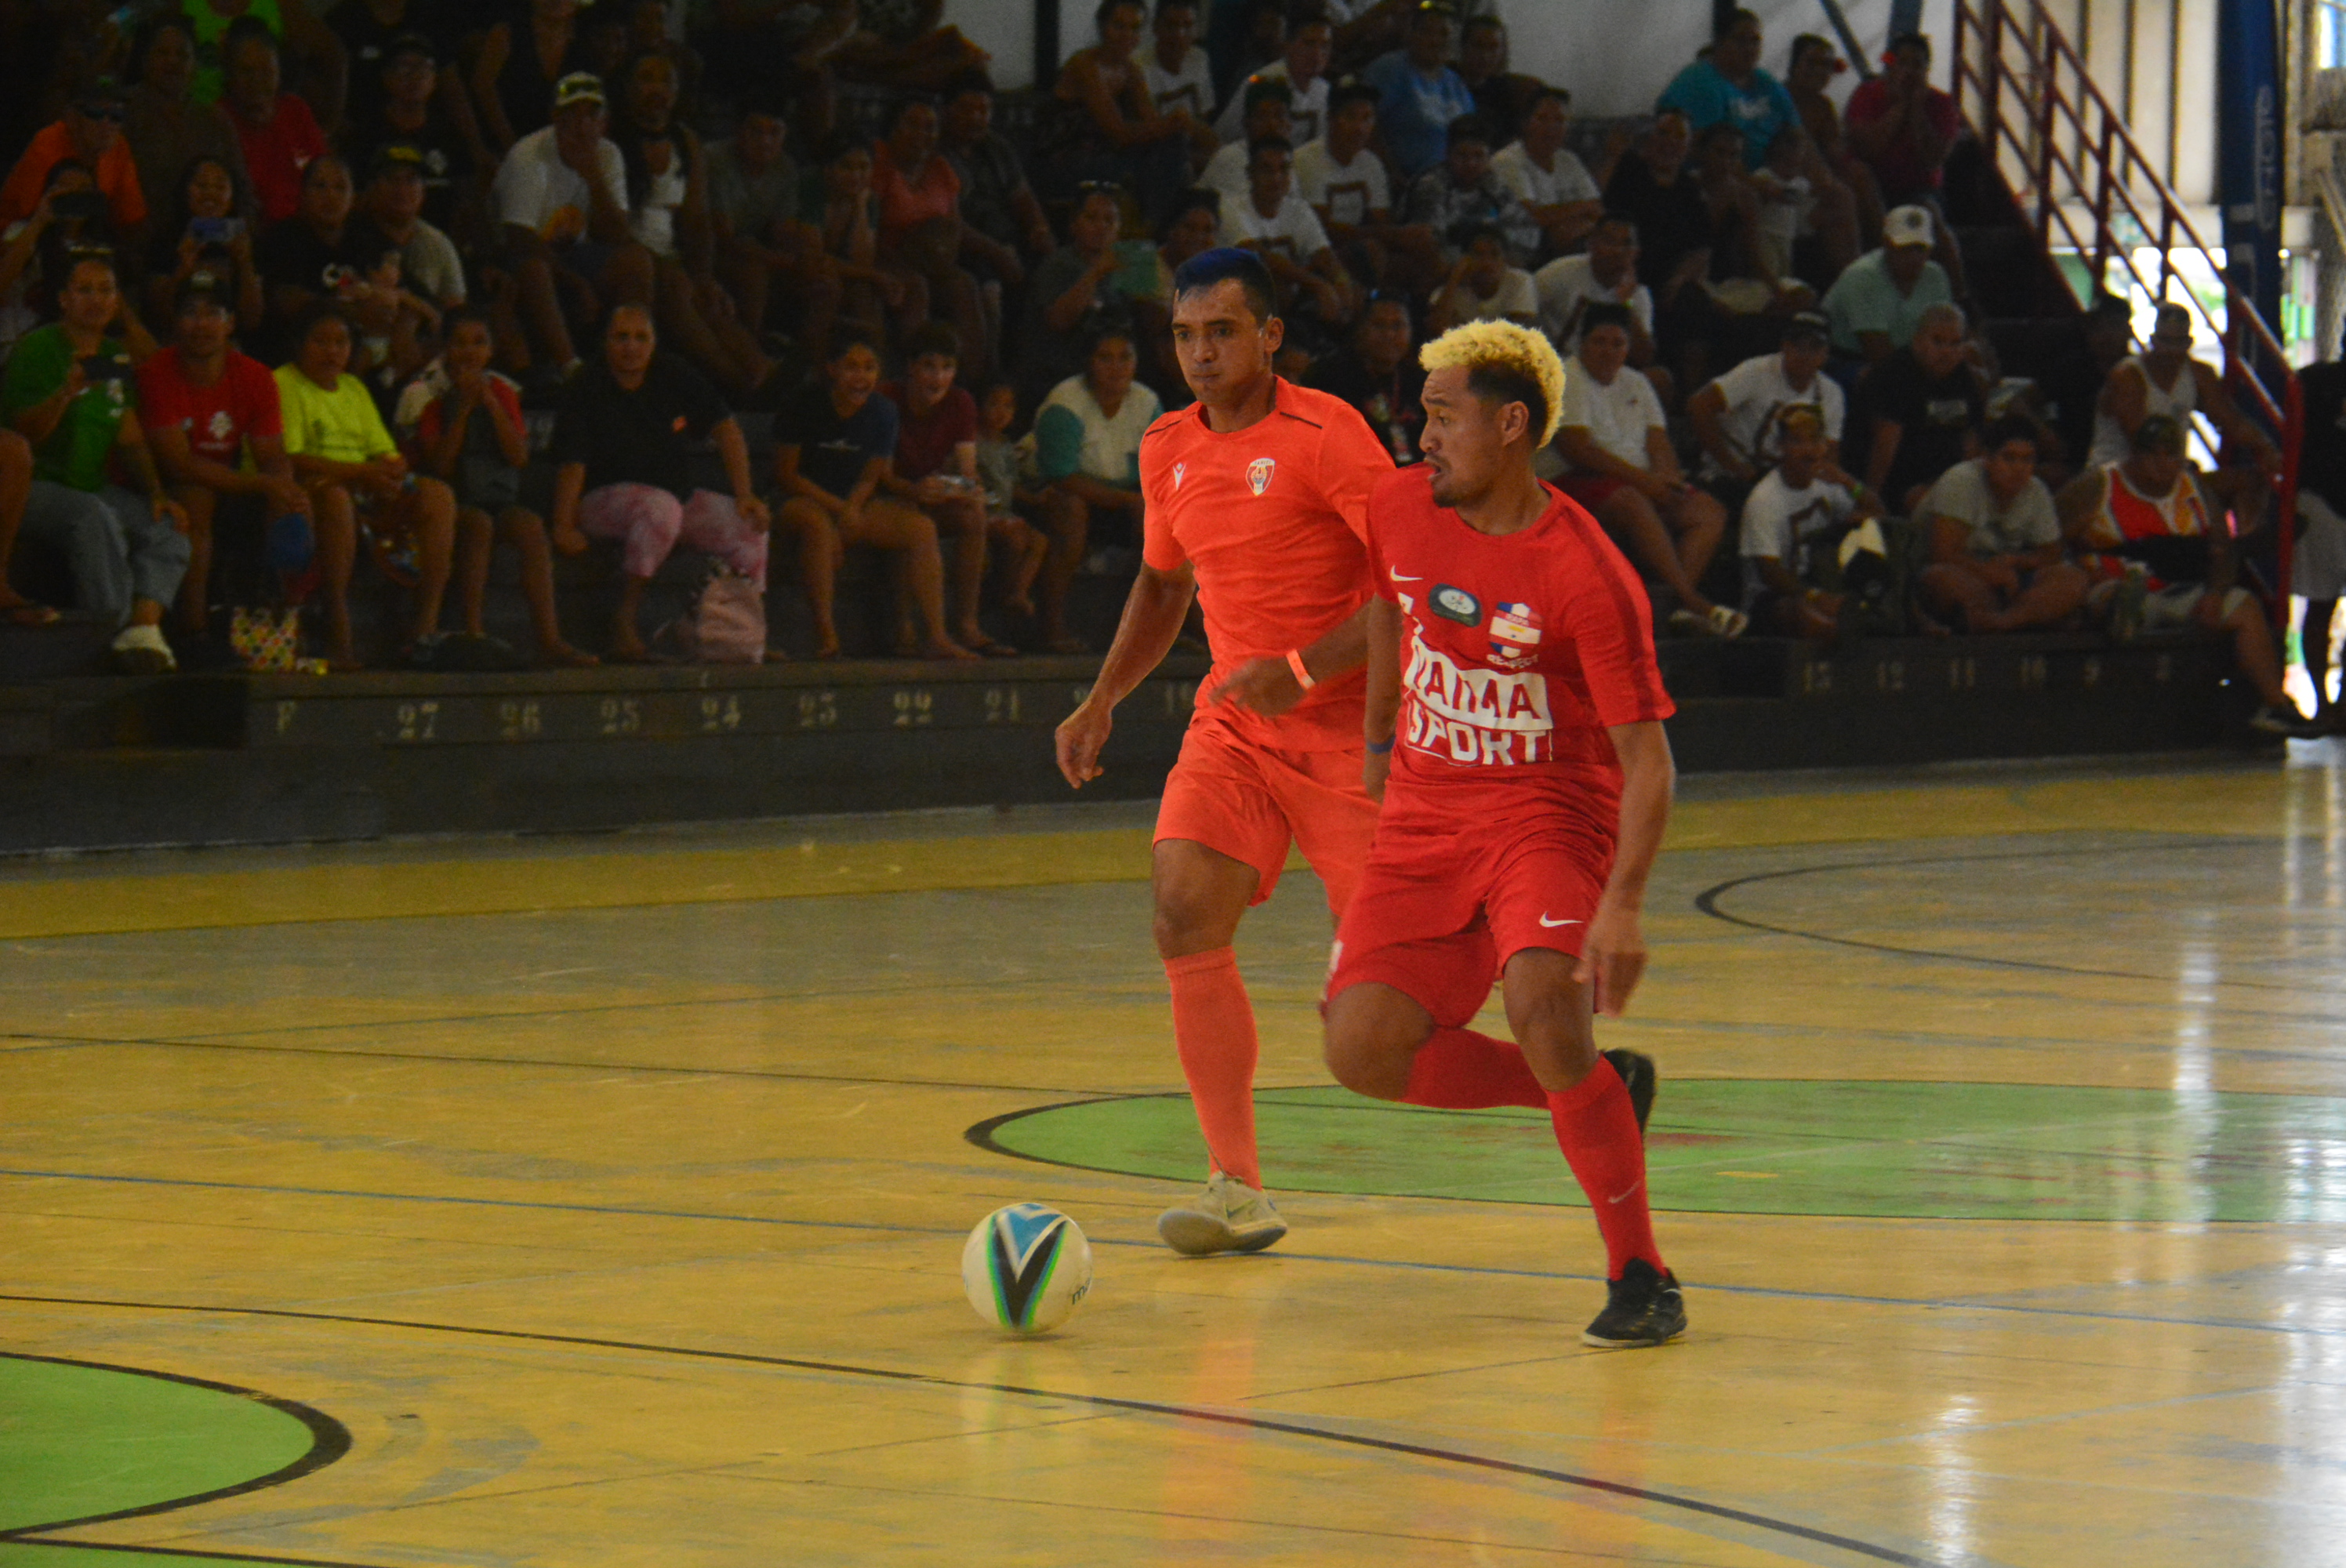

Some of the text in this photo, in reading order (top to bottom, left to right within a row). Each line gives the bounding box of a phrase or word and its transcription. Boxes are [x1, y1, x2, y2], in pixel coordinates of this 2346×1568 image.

[702, 695, 741, 731] 24
[893, 690, 933, 726] 22
[985, 683, 1019, 722] 21
[397, 703, 439, 739] 27
[1408, 699, 1547, 766] SPORT
